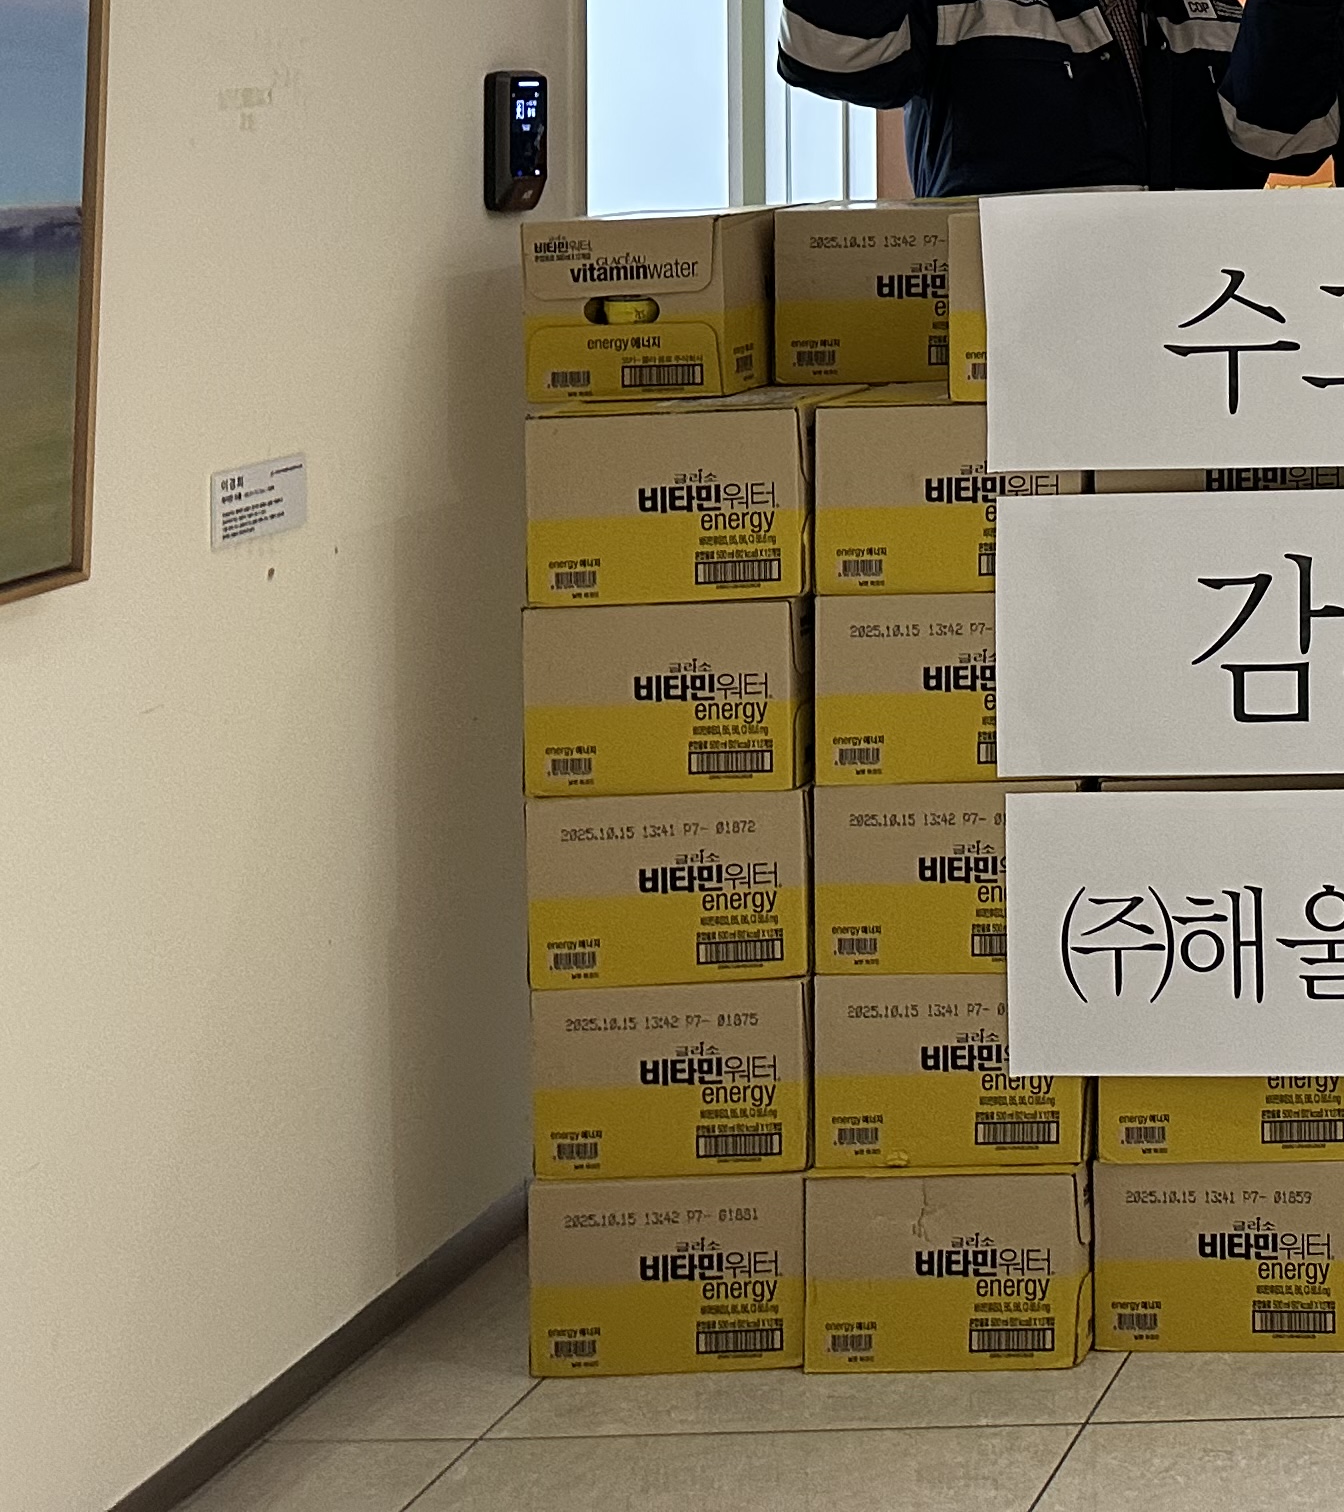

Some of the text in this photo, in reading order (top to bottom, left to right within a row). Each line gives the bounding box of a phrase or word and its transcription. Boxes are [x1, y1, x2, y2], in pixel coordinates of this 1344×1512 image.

[569, 259, 699, 284] vitaminwater
[587, 337, 629, 353] energy
[699, 509, 776, 534] energy
[693, 699, 769, 726] energy
[701, 888, 778, 914] energy
[701, 1082, 777, 1107] energy
[1257, 1260, 1331, 1285] energy
[975, 1276, 1050, 1302] energy
